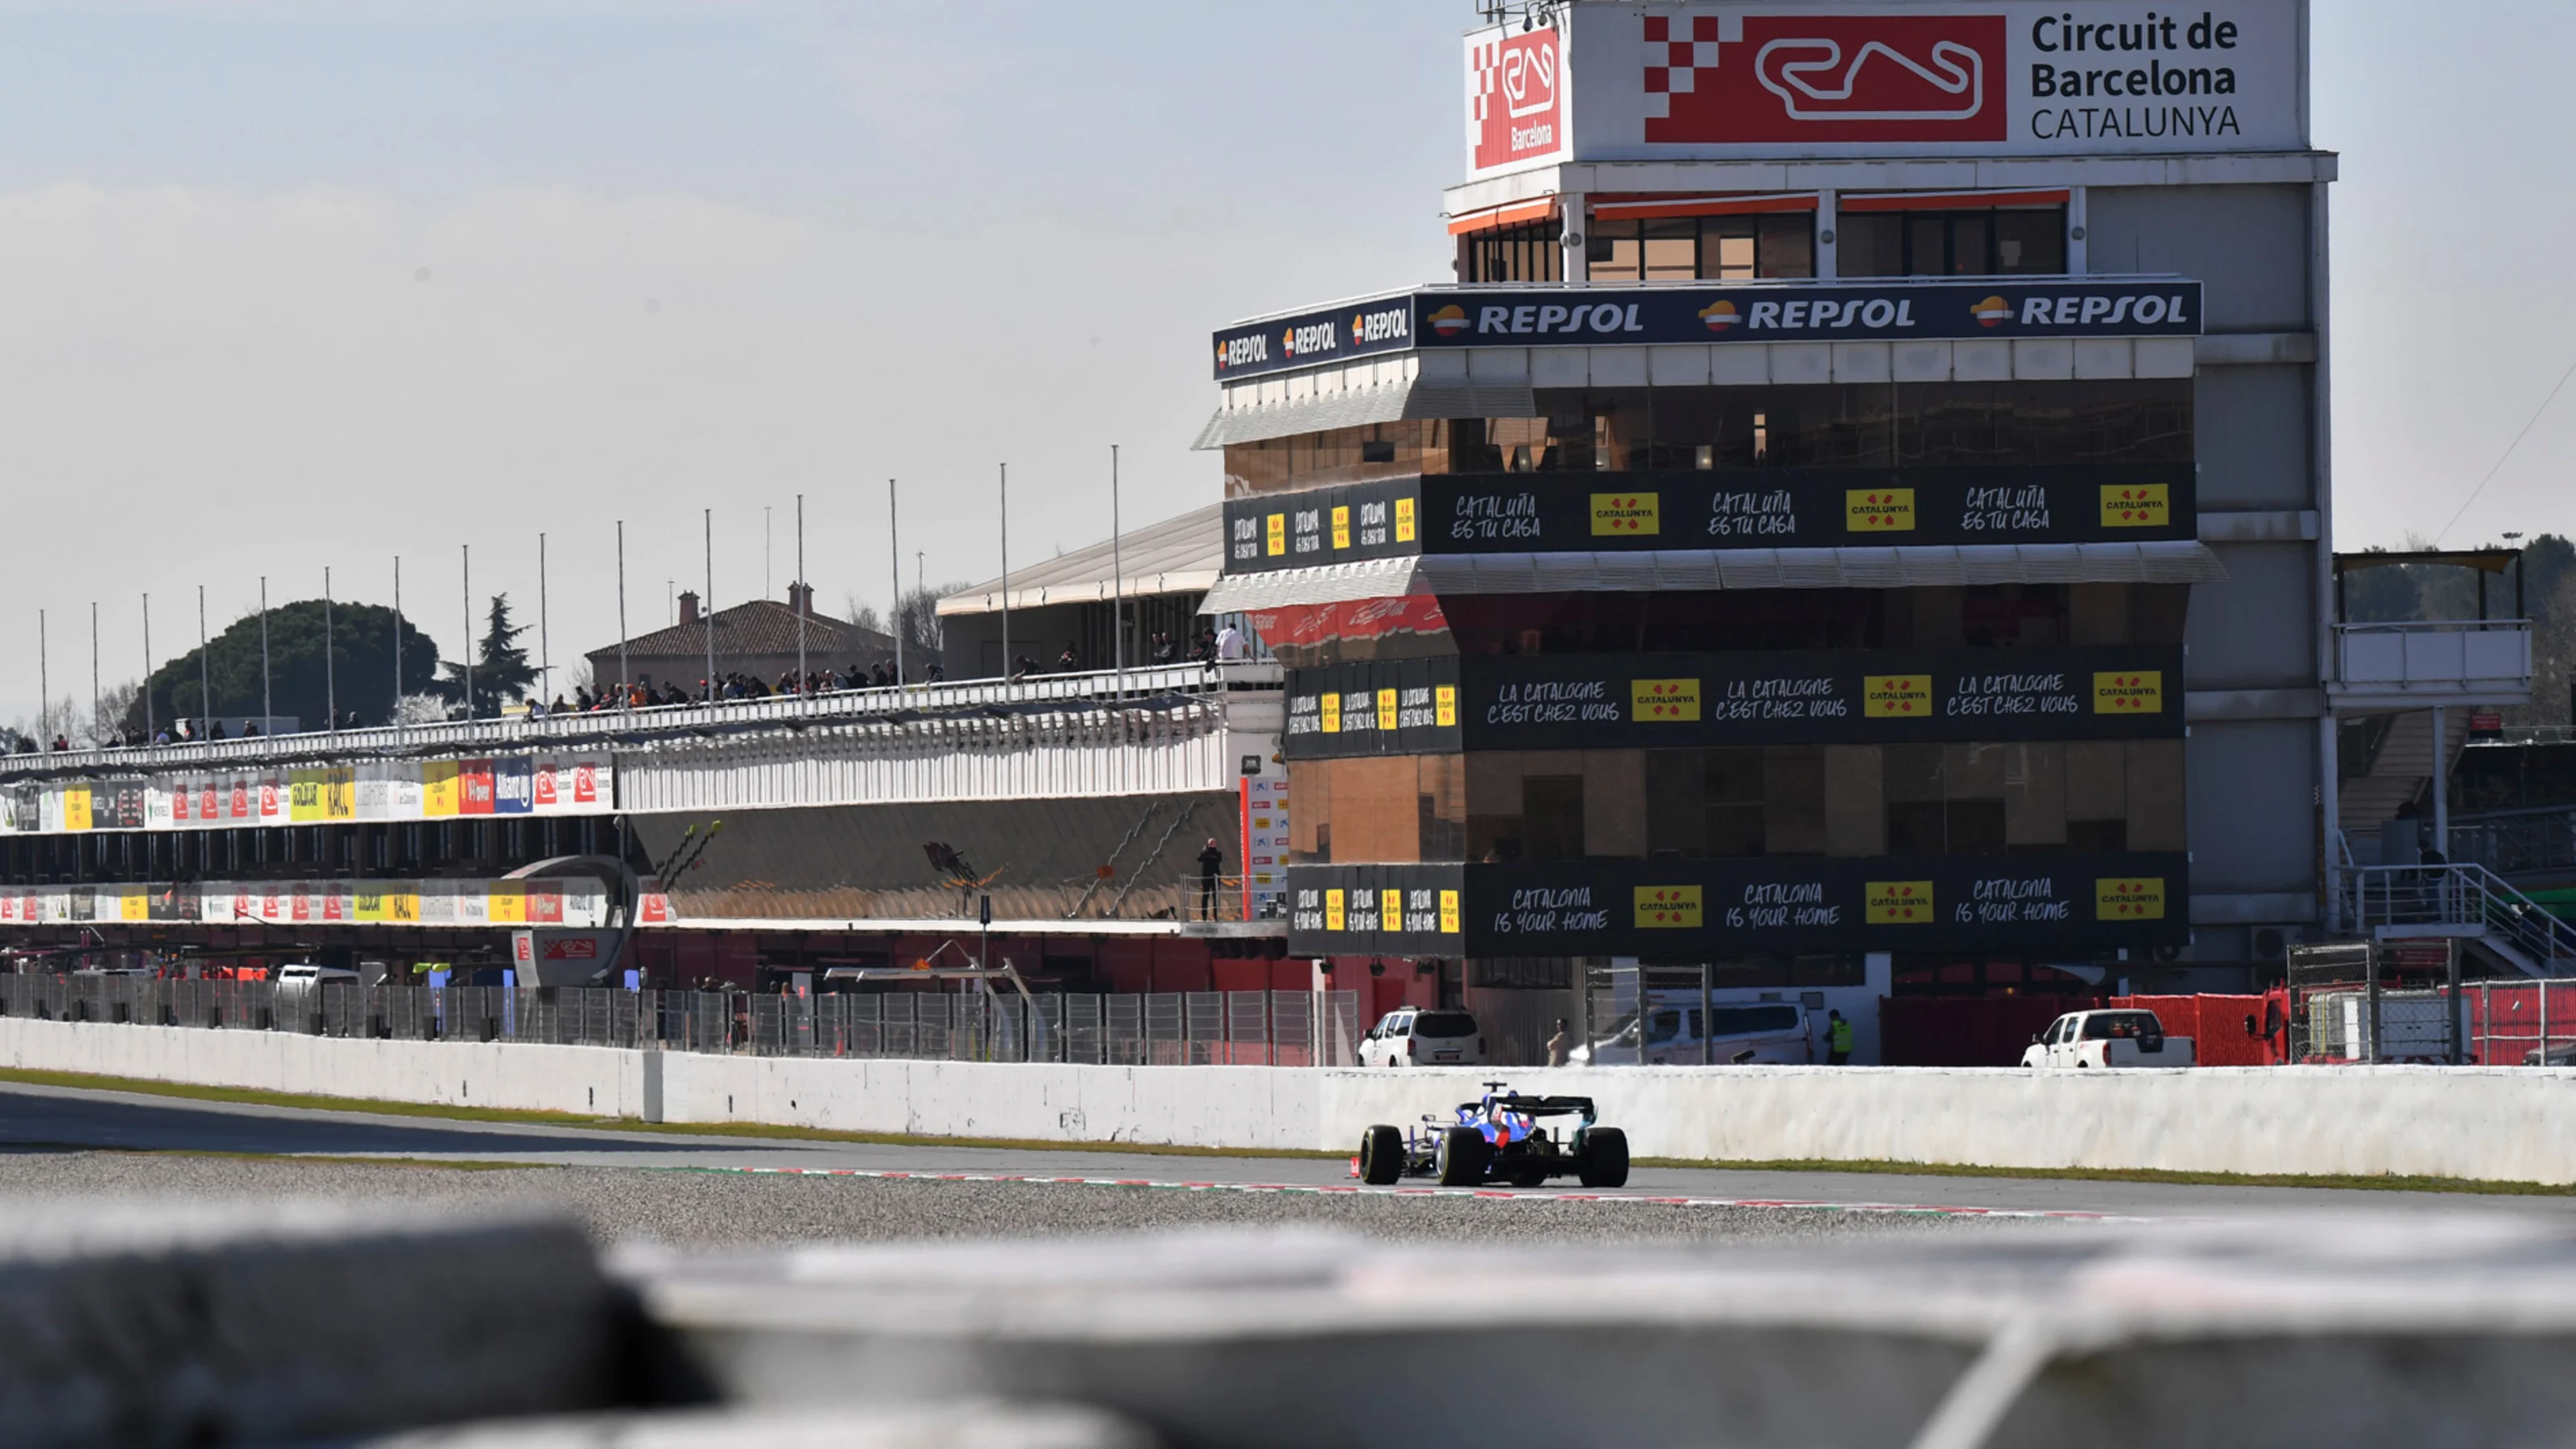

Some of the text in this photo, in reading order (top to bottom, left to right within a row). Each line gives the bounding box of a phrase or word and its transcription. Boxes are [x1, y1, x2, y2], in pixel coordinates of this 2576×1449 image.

[2032, 11, 2237, 52] Circuit de
[2032, 60, 2235, 97] Barcelona
[2032, 106, 2239, 138] CATALUNYA
[1511, 119, 1553, 152] Barcelona
[1478, 303, 1643, 333] REPSOL
[1749, 299, 1915, 328] REPSOL
[2022, 295, 2186, 324] REPSOL
[1365, 308, 1408, 342] REPSOL
[1296, 322, 1336, 355] REPSOL
[1229, 334, 1267, 366] REPSOL
[1457, 493, 1535, 518] CATALUÑA
[1714, 490, 1790, 514] CATALUÑA
[1967, 485, 2044, 509] CATALUÑA
[2106, 501, 2163, 509] CATALUNYA
[1596, 510, 1653, 518] CATALUNYA
[1852, 506, 1909, 514] CATALUNYA
[1962, 510, 2049, 530] ES TU CASA
[1451, 518, 1540, 539] ES TU CASA
[1708, 515, 1794, 535] ES TU CASA
[1499, 682, 1604, 702] LA CATALOGNE
[1728, 679, 1832, 698] LA CATALOGNE
[1870, 691, 1926, 700] CATALUNYA
[1959, 674, 2063, 695] LA CATALOGNE
[2099, 687, 2156, 696] CATALUNYA
[1488, 703, 1619, 723] C'EST CHEZ VOUS
[1717, 699, 1846, 720] C'EST CHEZ VOUS
[1947, 695, 2078, 716] C'EST CHEZ VOUS
[1513, 887, 1590, 910] CATALONIA
[1745, 883, 1821, 907] CATALONIA
[1974, 878, 2051, 899] CATALONIA
[2102, 894, 2159, 902] CATALUNYA
[1639, 902, 1697, 910] CATALUNYA
[1956, 901, 2069, 923] IS YOUR HOME
[1495, 910, 1608, 933] IS YOUR HOME
[1726, 906, 1839, 929] IS YOUR HOME
